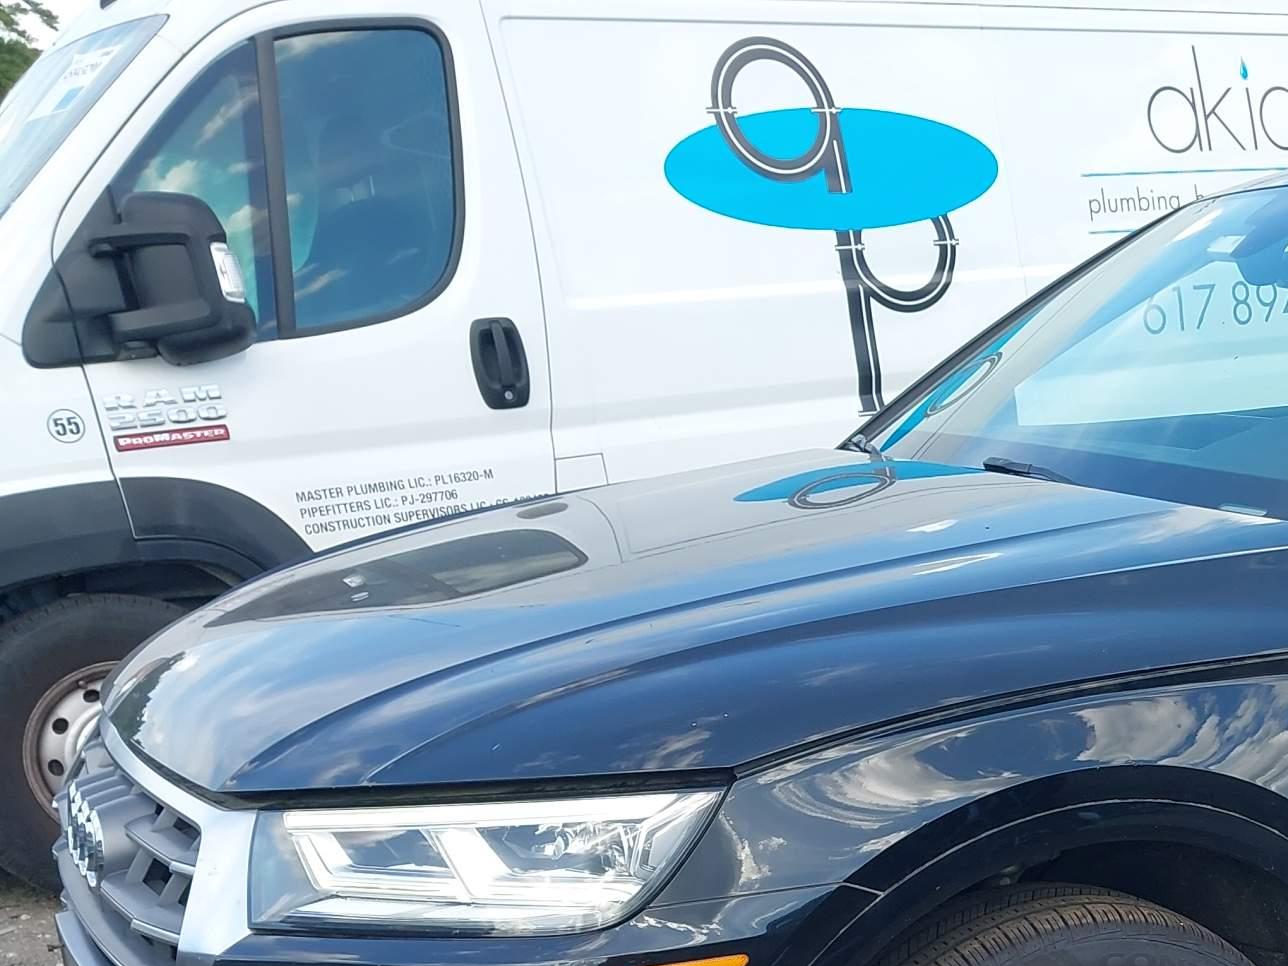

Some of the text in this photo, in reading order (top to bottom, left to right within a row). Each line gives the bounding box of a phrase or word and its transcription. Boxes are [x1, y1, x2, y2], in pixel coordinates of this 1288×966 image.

[1088, 186, 1180, 221] plumbing
[103, 384, 222, 411] RAM
[53, 417, 80, 436] 55
[295, 468, 494, 503] MASTER PLUMBING LIC.: PL16320-M
[300, 489, 458, 519] PIPEFITTERS LIC.: PJ-297706
[304, 514, 391, 536] CONSTRUCTION
[394, 503, 468, 524] SUPERVISORS
